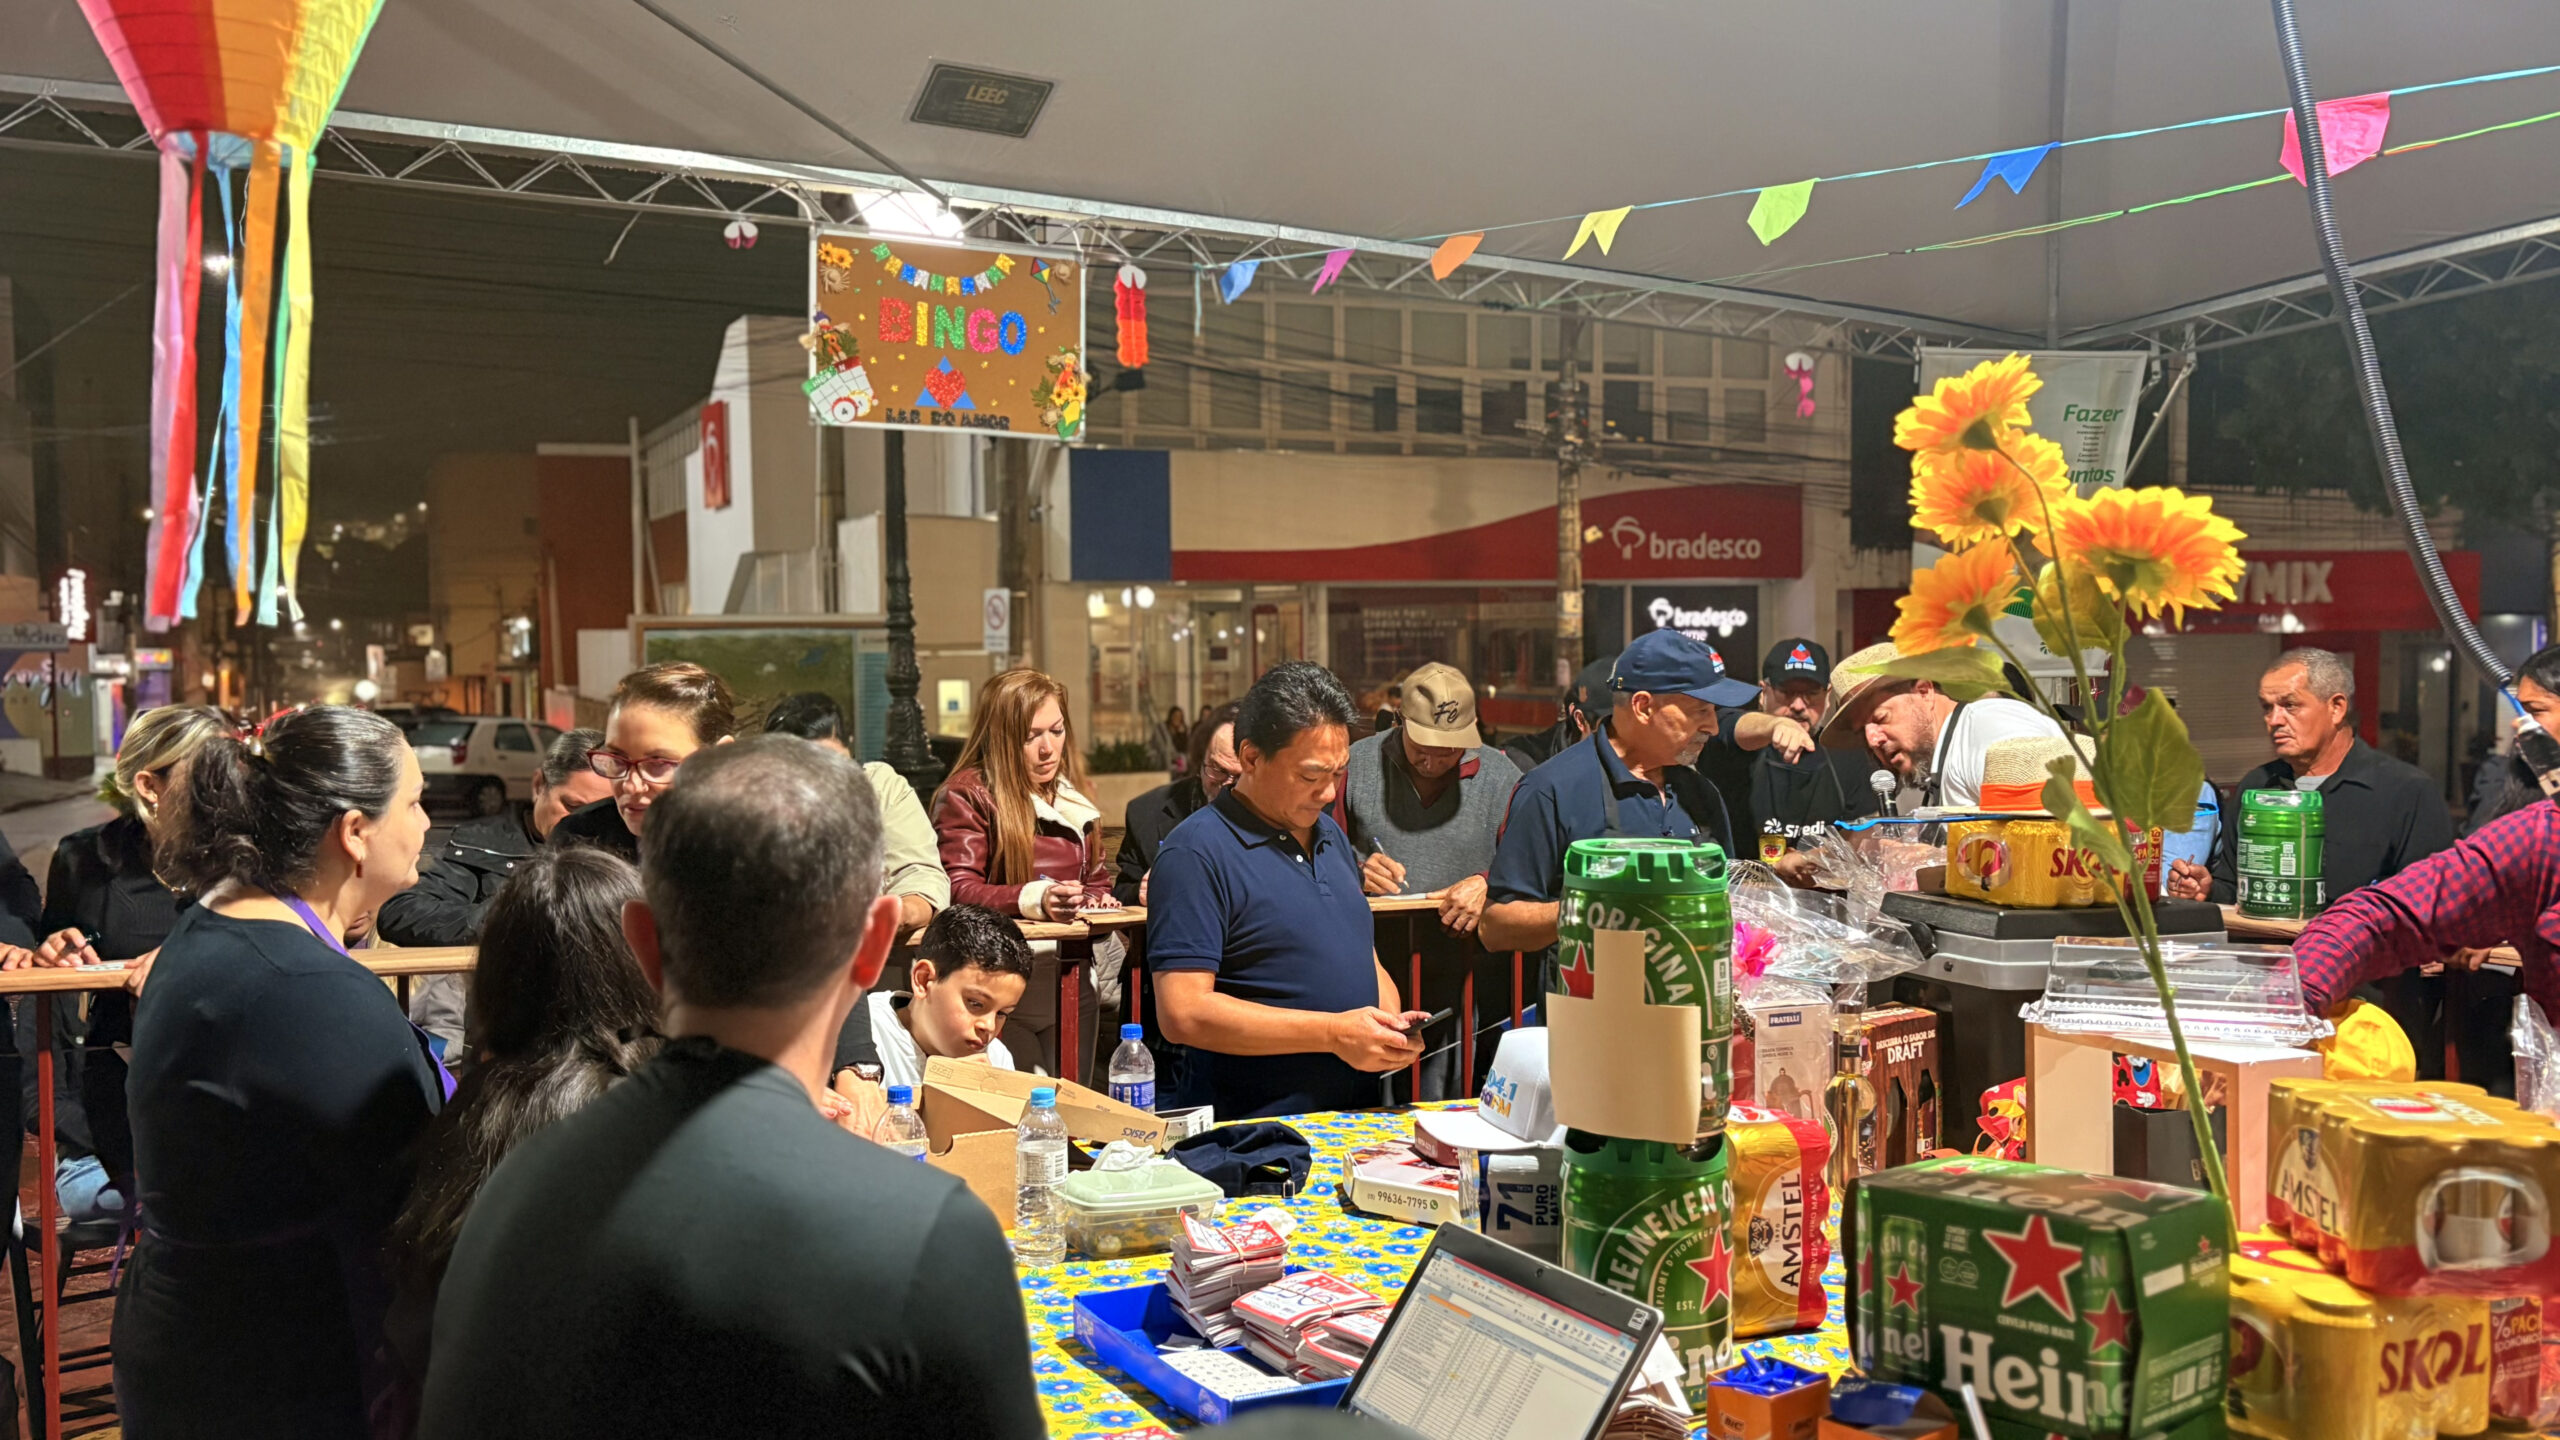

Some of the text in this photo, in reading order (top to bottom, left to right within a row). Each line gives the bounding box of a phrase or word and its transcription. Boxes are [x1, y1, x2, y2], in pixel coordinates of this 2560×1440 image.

[965, 85, 1009, 104] LEEC
[879, 297, 1027, 355] BINGO
[886, 408, 1010, 431] LAR DO AMOR
[2064, 404, 2123, 422] Fazer
[1651, 532, 1762, 559] bradesco
[1673, 606, 1748, 628] bradesco
[1587, 901, 1697, 1006] ORIGINA
[1770, 1014, 1800, 1025] FRATELLI
[1876, 1030, 1936, 1050] DESCUBRA O SABOR DE
[1887, 1041, 1924, 1064] DRAFT
[1377, 1190, 1428, 1209] 99636-7795
[1497, 1182, 1533, 1230] 71
[1535, 1184, 1549, 1226] PURO
[1781, 1173, 1803, 1287] AMSTEL
[1607, 1184, 1717, 1301] HEINEKEN
[1676, 1300, 1697, 1311] EST.
[1997, 1315, 2075, 1341] CERVEJA PURO MALTE
[2378, 1323, 2488, 1398] SKOL
[1724, 1415, 1744, 1430] BIC
